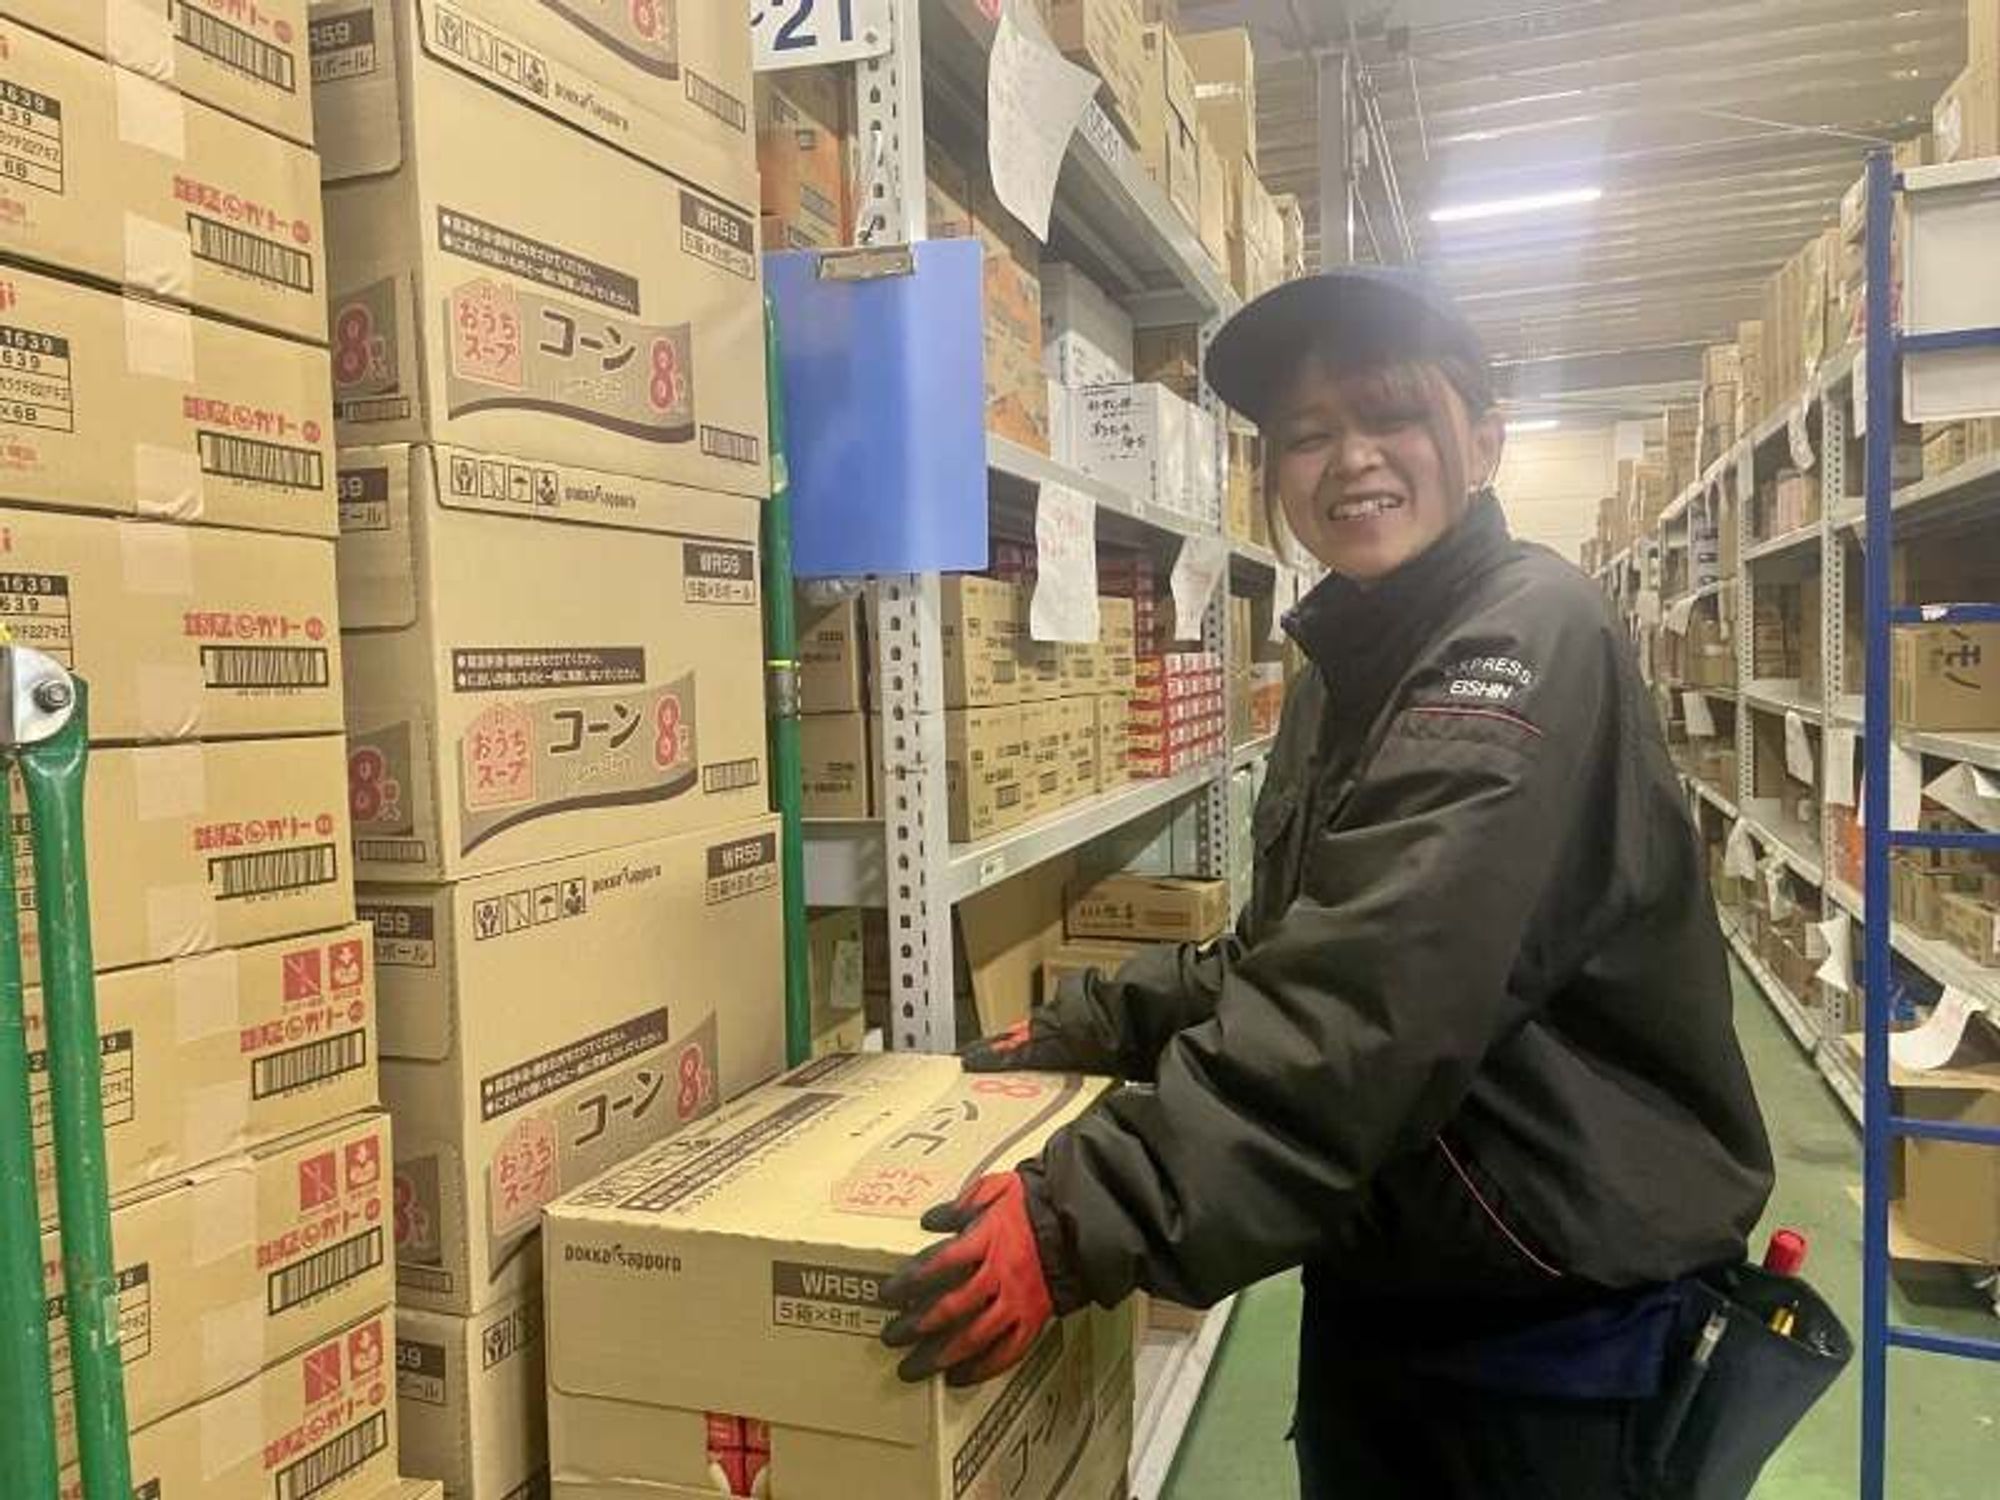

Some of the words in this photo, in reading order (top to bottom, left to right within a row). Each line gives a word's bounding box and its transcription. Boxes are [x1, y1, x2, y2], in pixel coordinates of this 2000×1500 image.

[460, 300, 516, 341] おうち
[3, 330, 53, 353] 1639
[464, 333, 517, 368] スープ
[540, 310, 635, 370] コーン
[699, 551, 741, 575] WR59
[2, 576, 51, 593] 1639
[1450, 679, 1514, 699] EISHIN
[550, 703, 641, 755] コーン
[475, 730, 527, 761] おうち
[479, 757, 528, 788] スープ
[722, 841, 762, 868] WR59
[575, 1072, 665, 1146] コーン
[890, 1099, 979, 1156] コーン
[800, 1270, 880, 1301] WR59
[780, 1302, 882, 1329] 5箱×8ボー
